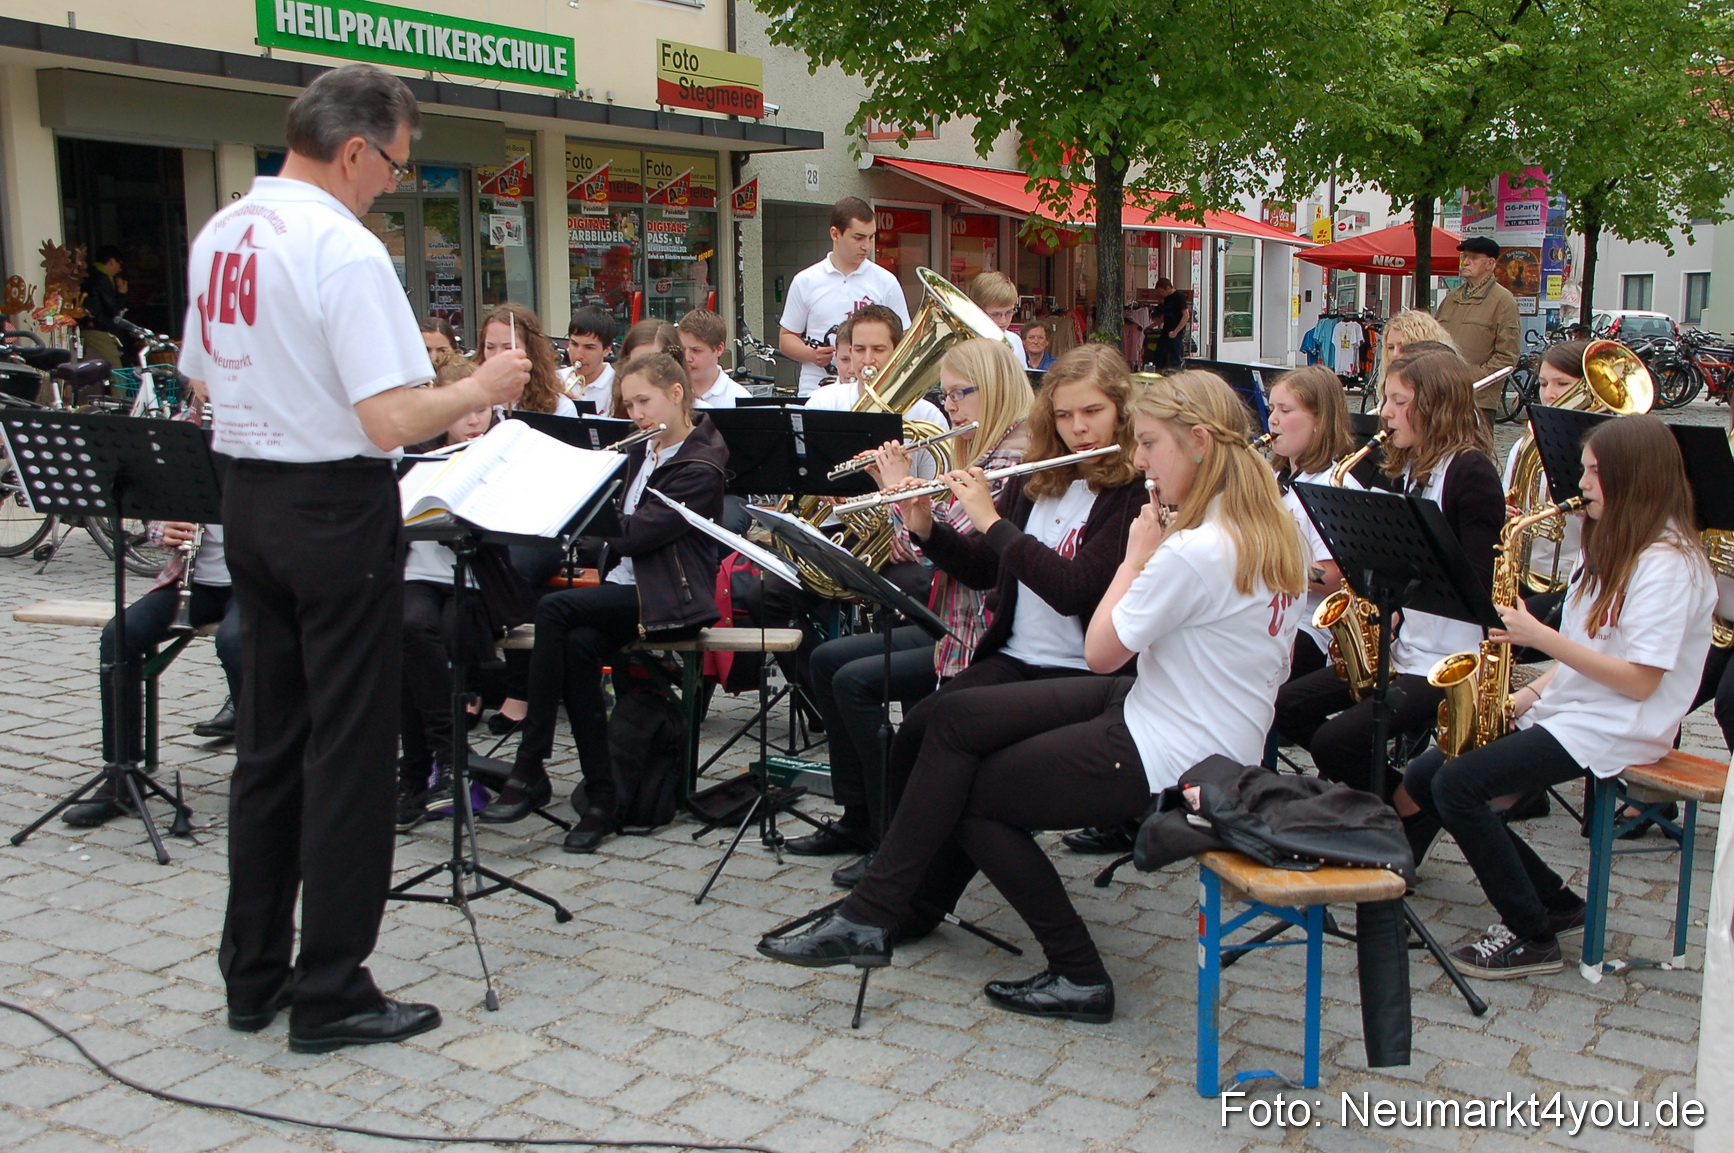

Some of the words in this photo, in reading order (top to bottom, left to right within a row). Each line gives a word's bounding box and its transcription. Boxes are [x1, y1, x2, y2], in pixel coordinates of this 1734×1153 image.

[275, 0, 568, 76] HEILPRAKTIKERSCHULE
[662, 43, 699, 72] Foto
[679, 76, 760, 110] Stegmeier
[566, 151, 593, 170] Foto
[647, 159, 672, 177] Foto
[807, 170, 819, 184] 28
[567, 218, 611, 231] DIGITALE
[647, 221, 687, 233] DIGITALE
[876, 211, 894, 230] KD
[951, 219, 967, 234] KD
[568, 230, 625, 243] FARBBILDER
[1373, 254, 1406, 268] NKD
[213, 349, 253, 370] Neumarkt
